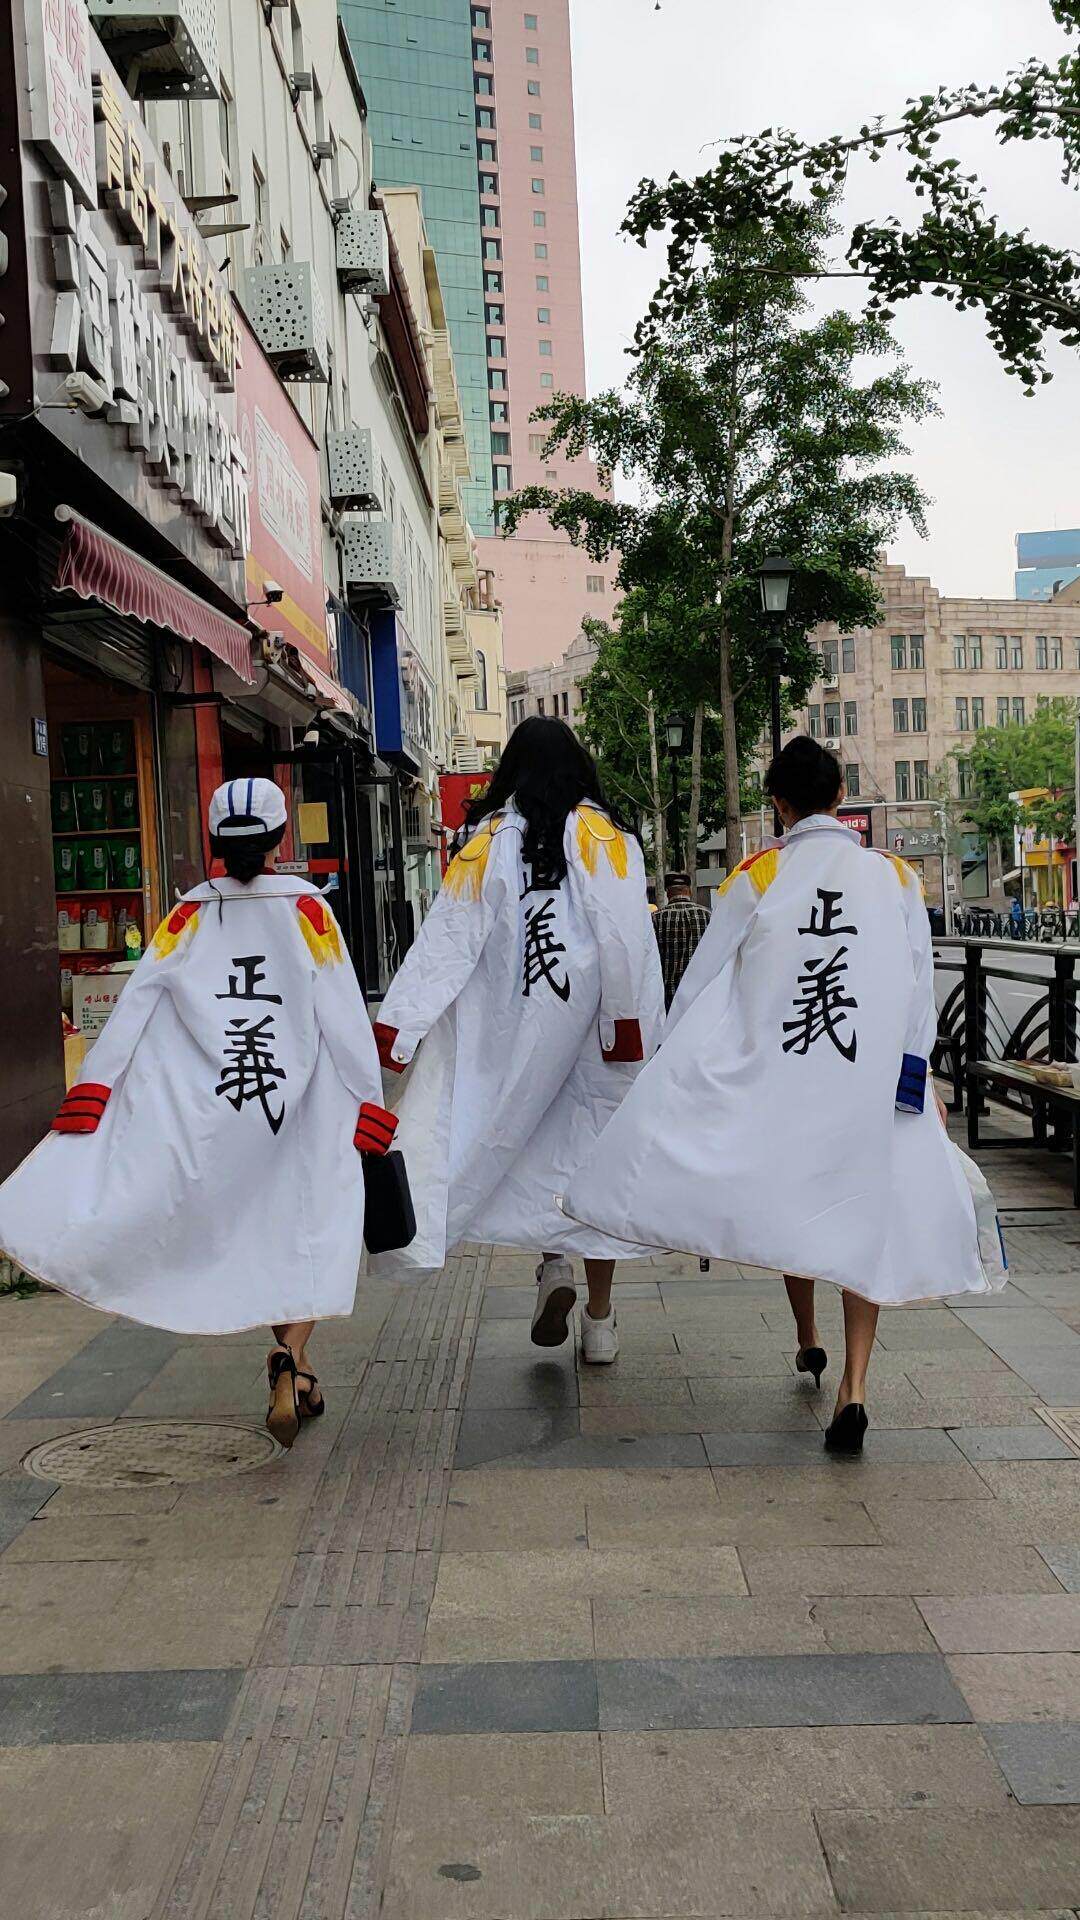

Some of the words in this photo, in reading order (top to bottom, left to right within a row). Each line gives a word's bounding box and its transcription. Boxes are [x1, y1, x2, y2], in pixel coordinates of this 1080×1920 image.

[52, 181, 251, 560] 海鲜购物超市
[215, 955, 286, 1136] 正義
[782, 888, 858, 1063] 正義
